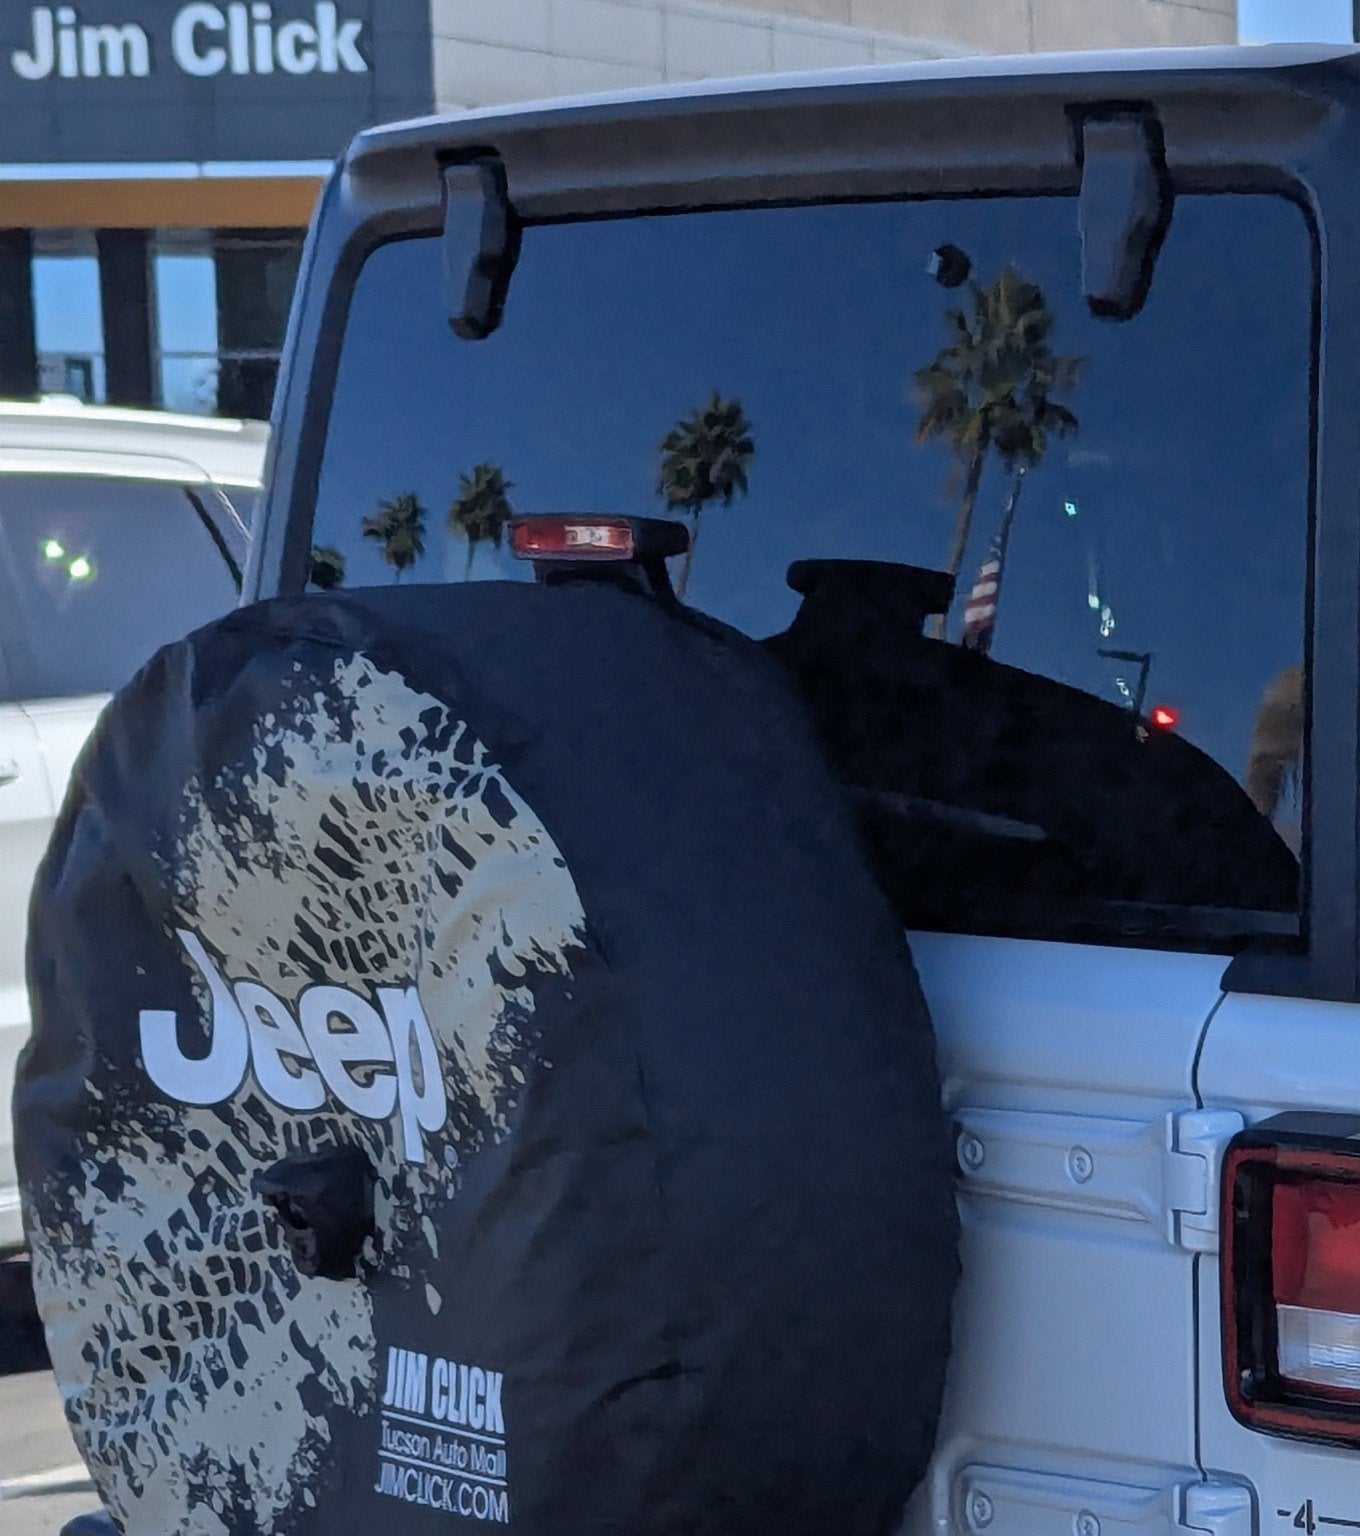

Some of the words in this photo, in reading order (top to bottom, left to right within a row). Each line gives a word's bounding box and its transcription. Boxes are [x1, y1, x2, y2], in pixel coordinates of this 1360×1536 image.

[11, 6, 150, 80] Jim
[172, 0, 368, 76] Click
[139, 927, 448, 1164] Jeep
[383, 1346, 428, 1415] JIM
[431, 1358, 506, 1434] CLICK
[433, 1434, 468, 1469] Auto
[470, 1443, 507, 1478] Mall
[1294, 1499, 1316, 1536] 4
